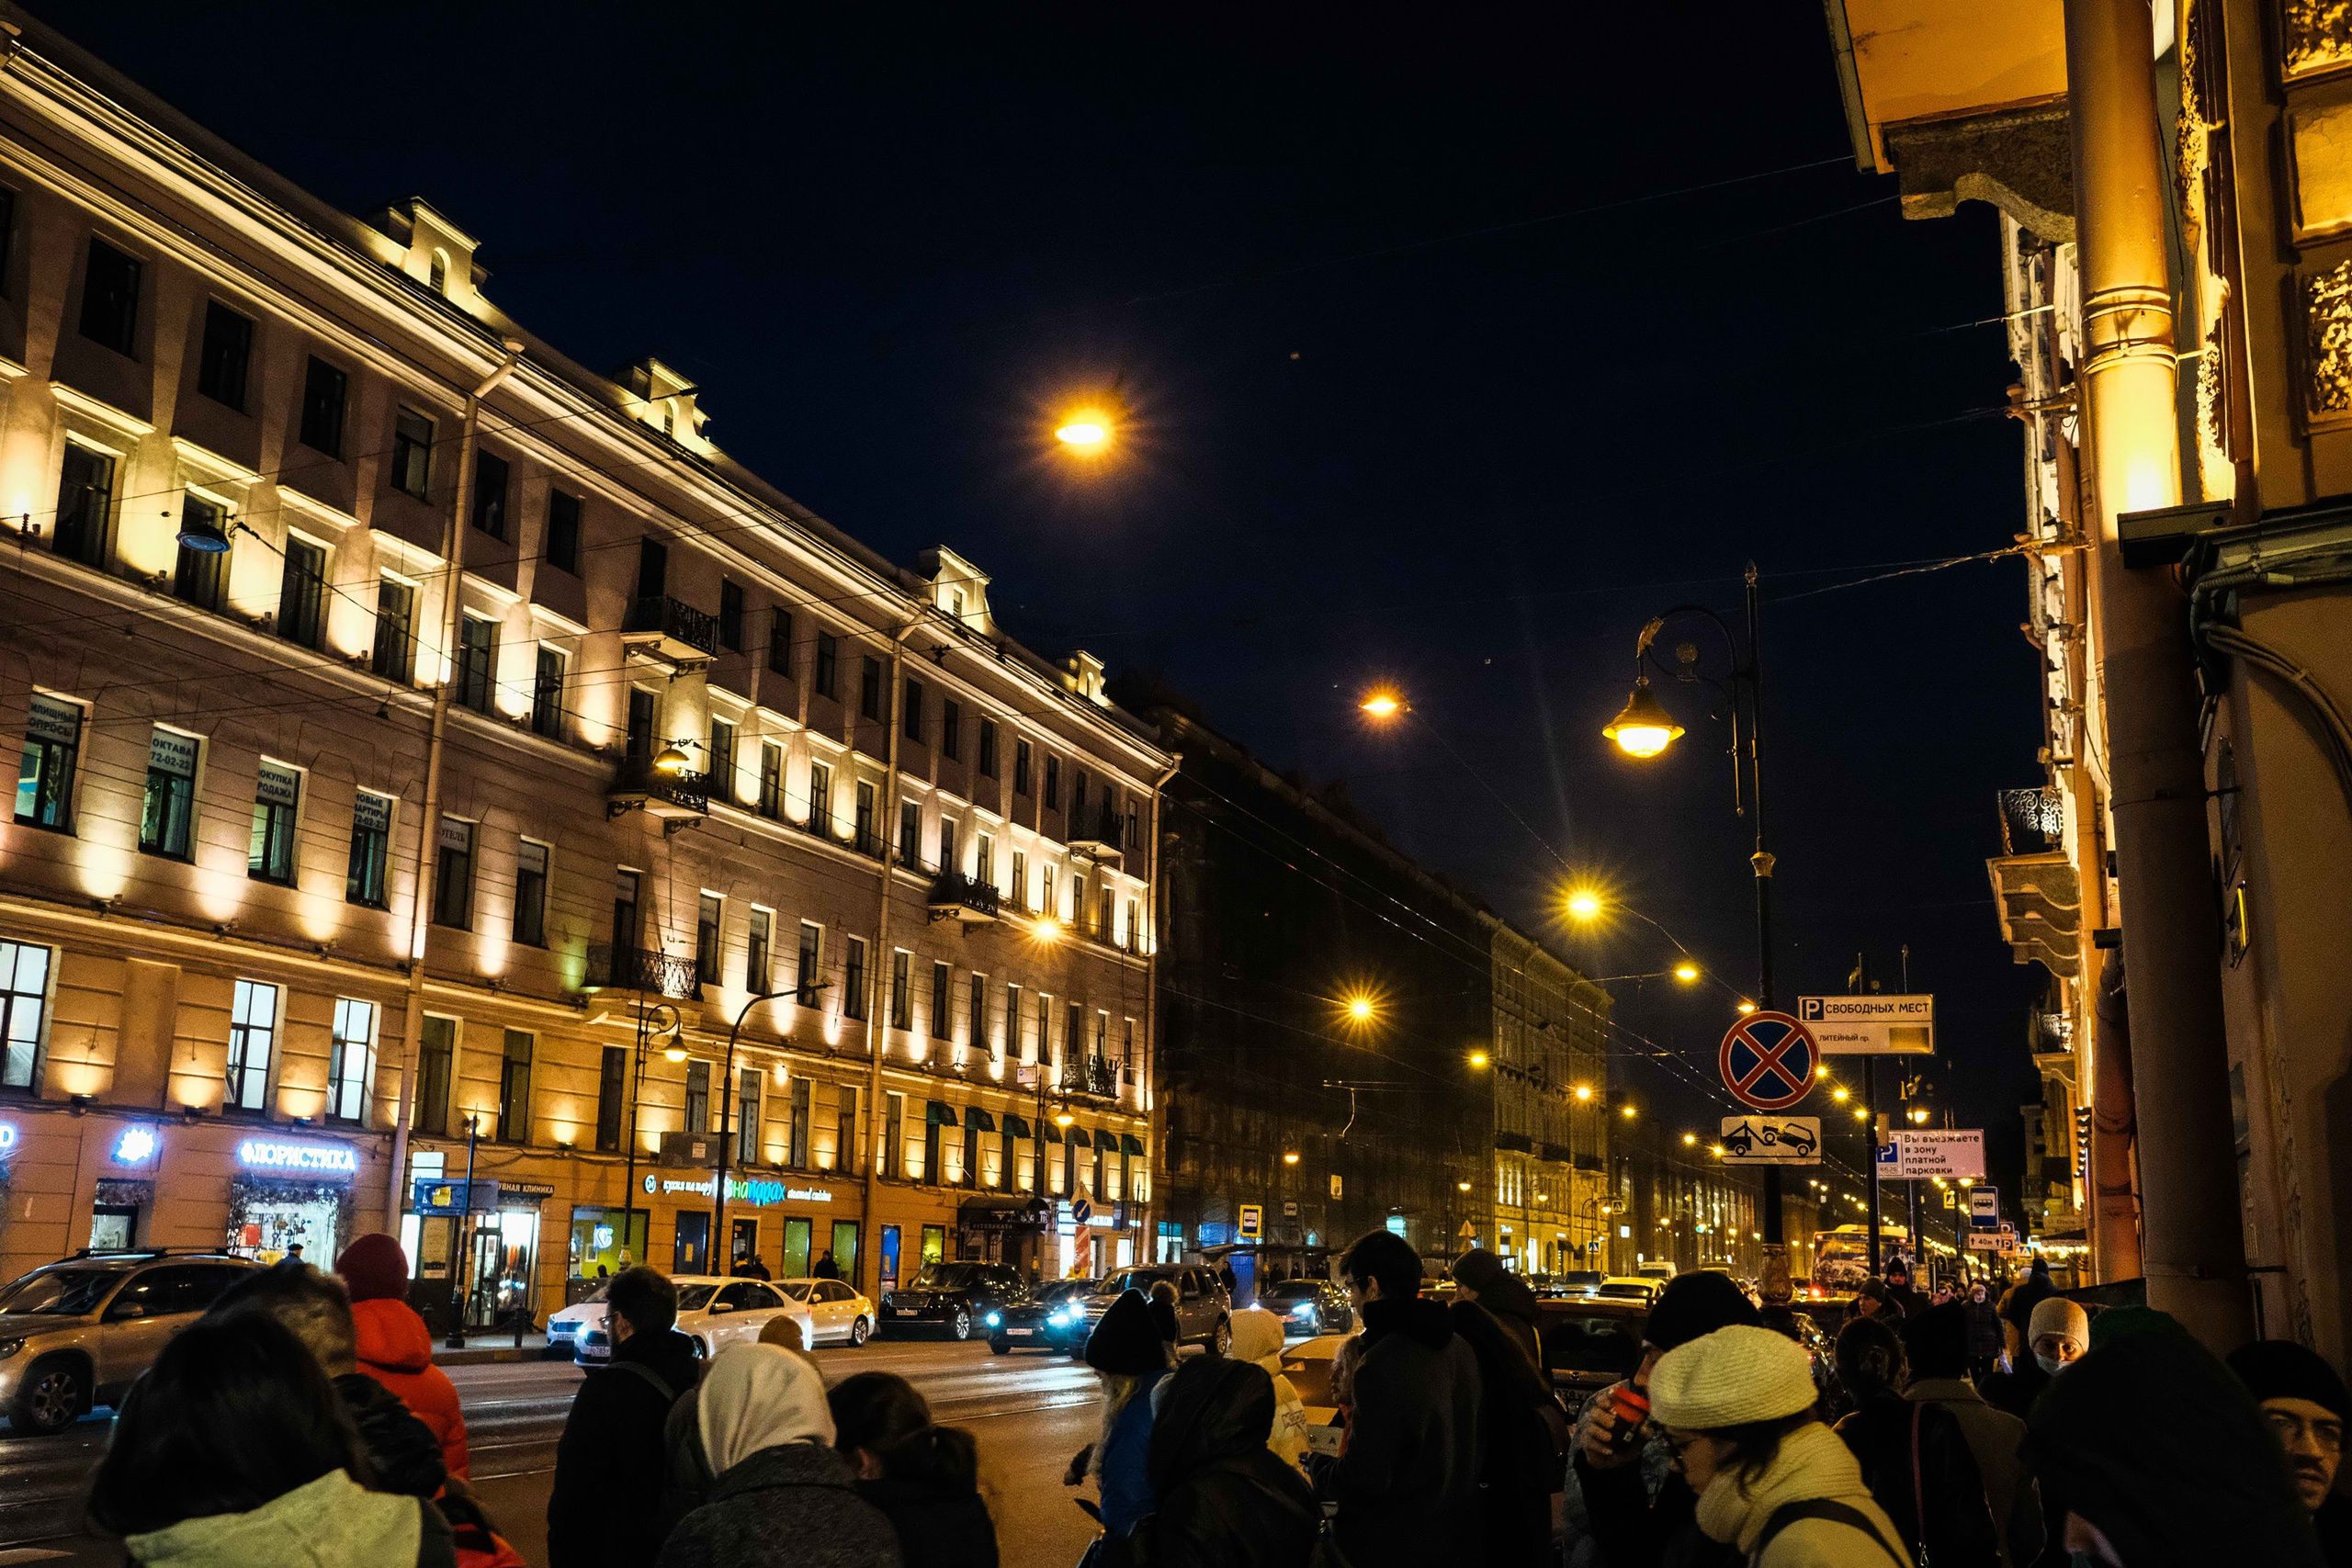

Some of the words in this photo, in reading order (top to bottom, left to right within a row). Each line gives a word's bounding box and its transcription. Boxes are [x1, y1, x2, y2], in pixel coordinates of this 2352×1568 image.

[153, 738, 193, 757] ОКТАВА
[1826, 1003, 1894, 1014] СВОБОДНЫХ
[1898, 1003, 1929, 1013] МЕСТ
[1819, 1033, 1859, 1042] ЛИТЕЙНЫЙ
[1905, 1134, 1919, 1144] Вы
[1914, 1146, 1938, 1155] зону
[240, 1142, 356, 1171] ФЛОРИСТИКА
[1905, 1156, 1947, 1164] платной
[1905, 1168, 1953, 1176] парковки
[522, 1184, 554, 1194] КЛИНИКА
